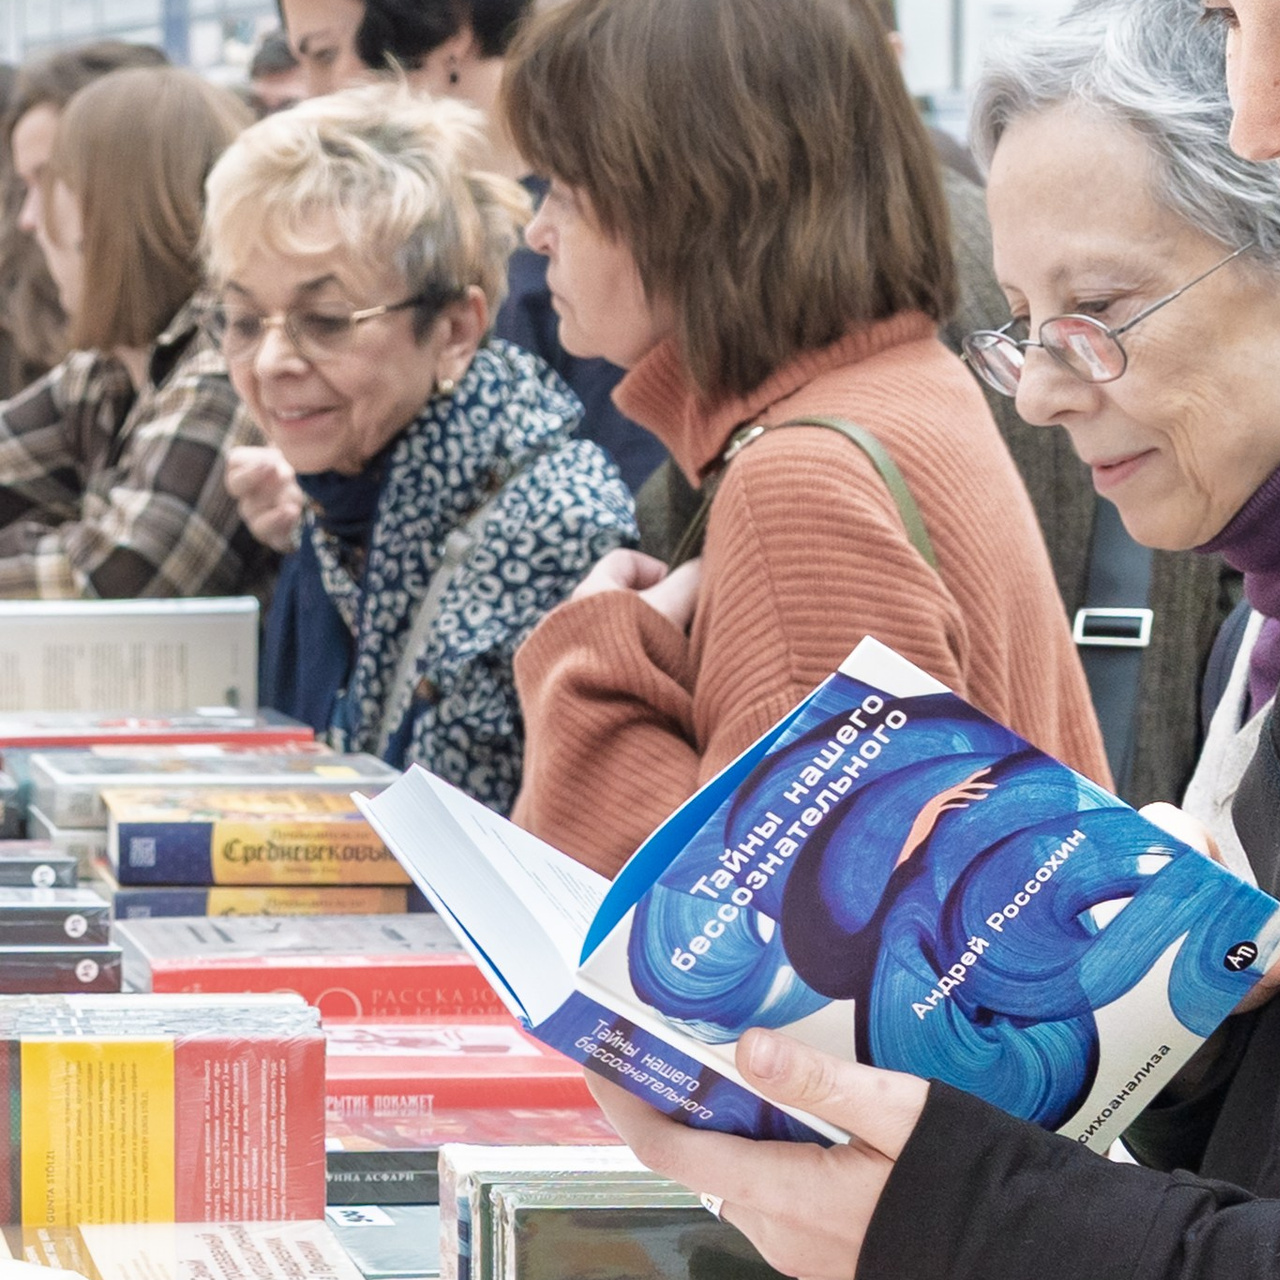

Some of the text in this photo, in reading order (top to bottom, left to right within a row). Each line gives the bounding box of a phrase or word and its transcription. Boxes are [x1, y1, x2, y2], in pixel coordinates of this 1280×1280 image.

[670, 710, 907, 971] бессознательного
[690, 695, 884, 899] Тайны нашего
[911, 828, 1086, 1019] Андрей Россохин
[371, 989, 500, 1005] РАССКАЗО
[574, 1035, 714, 1120] бессознательного
[591, 1019, 700, 1092] Тайны нашего
[1078, 1043, 1171, 1145] сихоанализа
